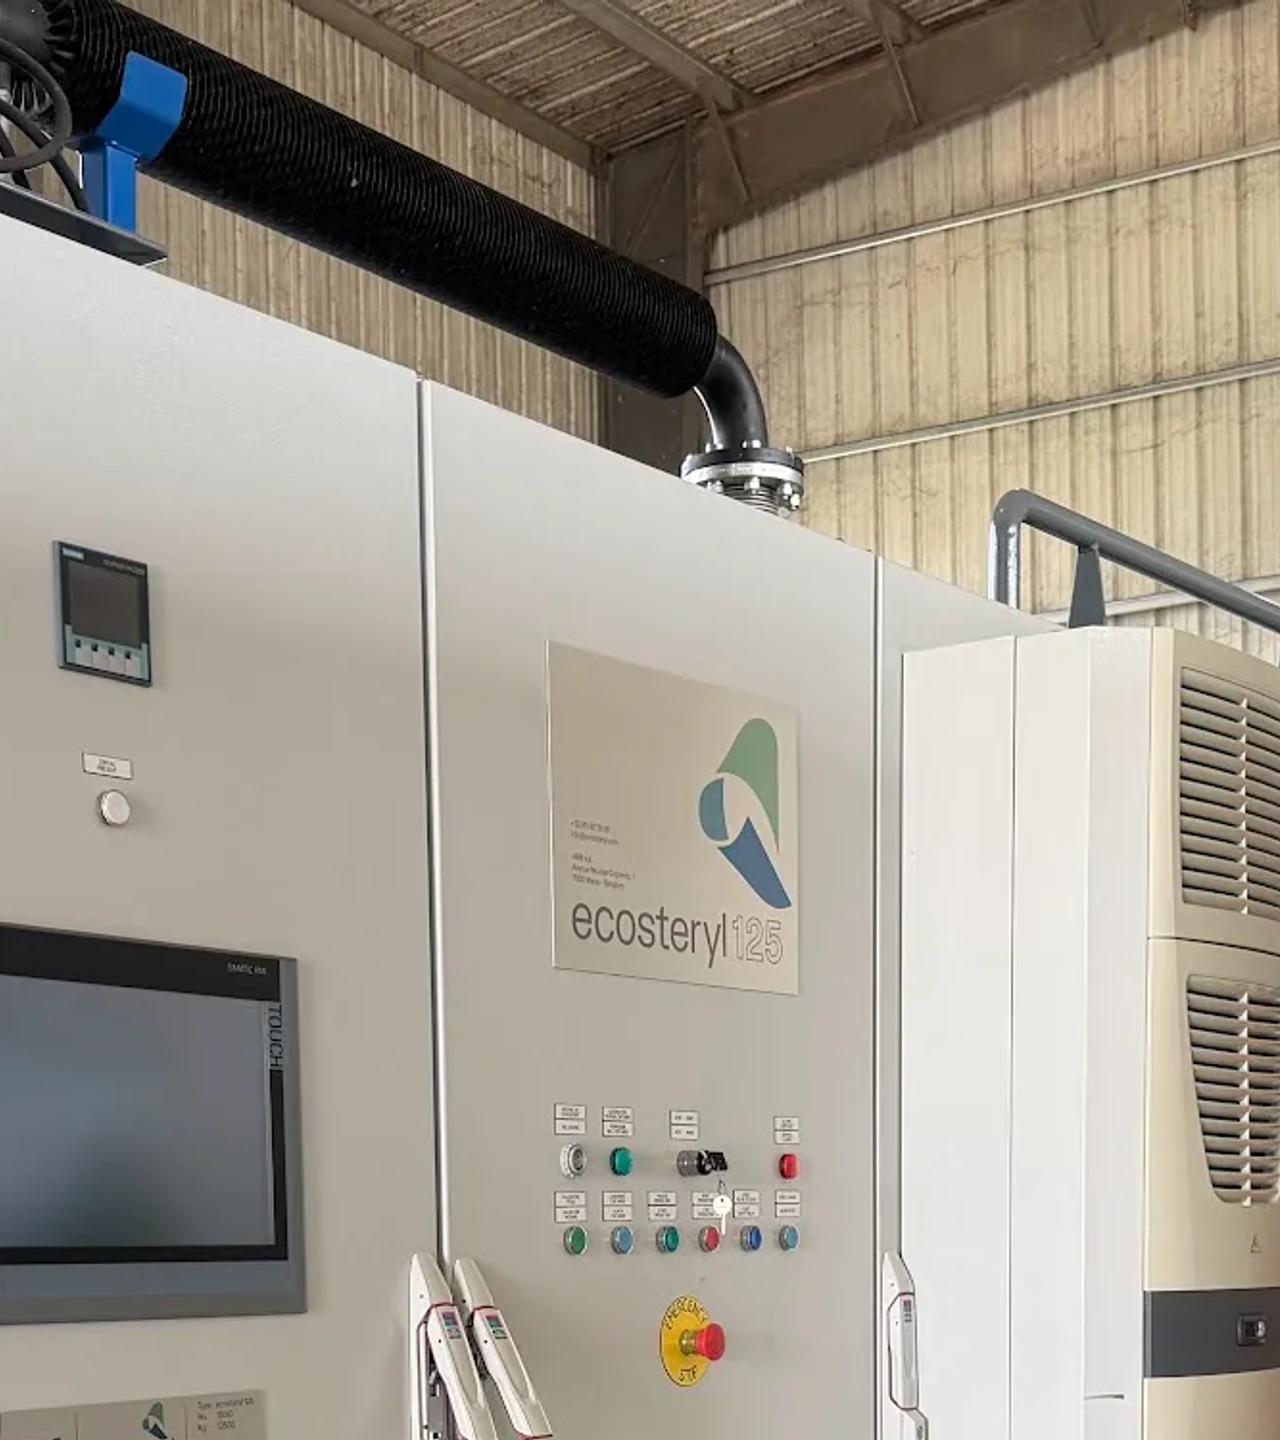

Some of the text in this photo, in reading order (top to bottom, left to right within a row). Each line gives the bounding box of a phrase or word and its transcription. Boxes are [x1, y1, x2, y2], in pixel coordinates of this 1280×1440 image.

[572, 902, 784, 968] ecosteryl 125
[268, 1005, 284, 1068] TOUCH
